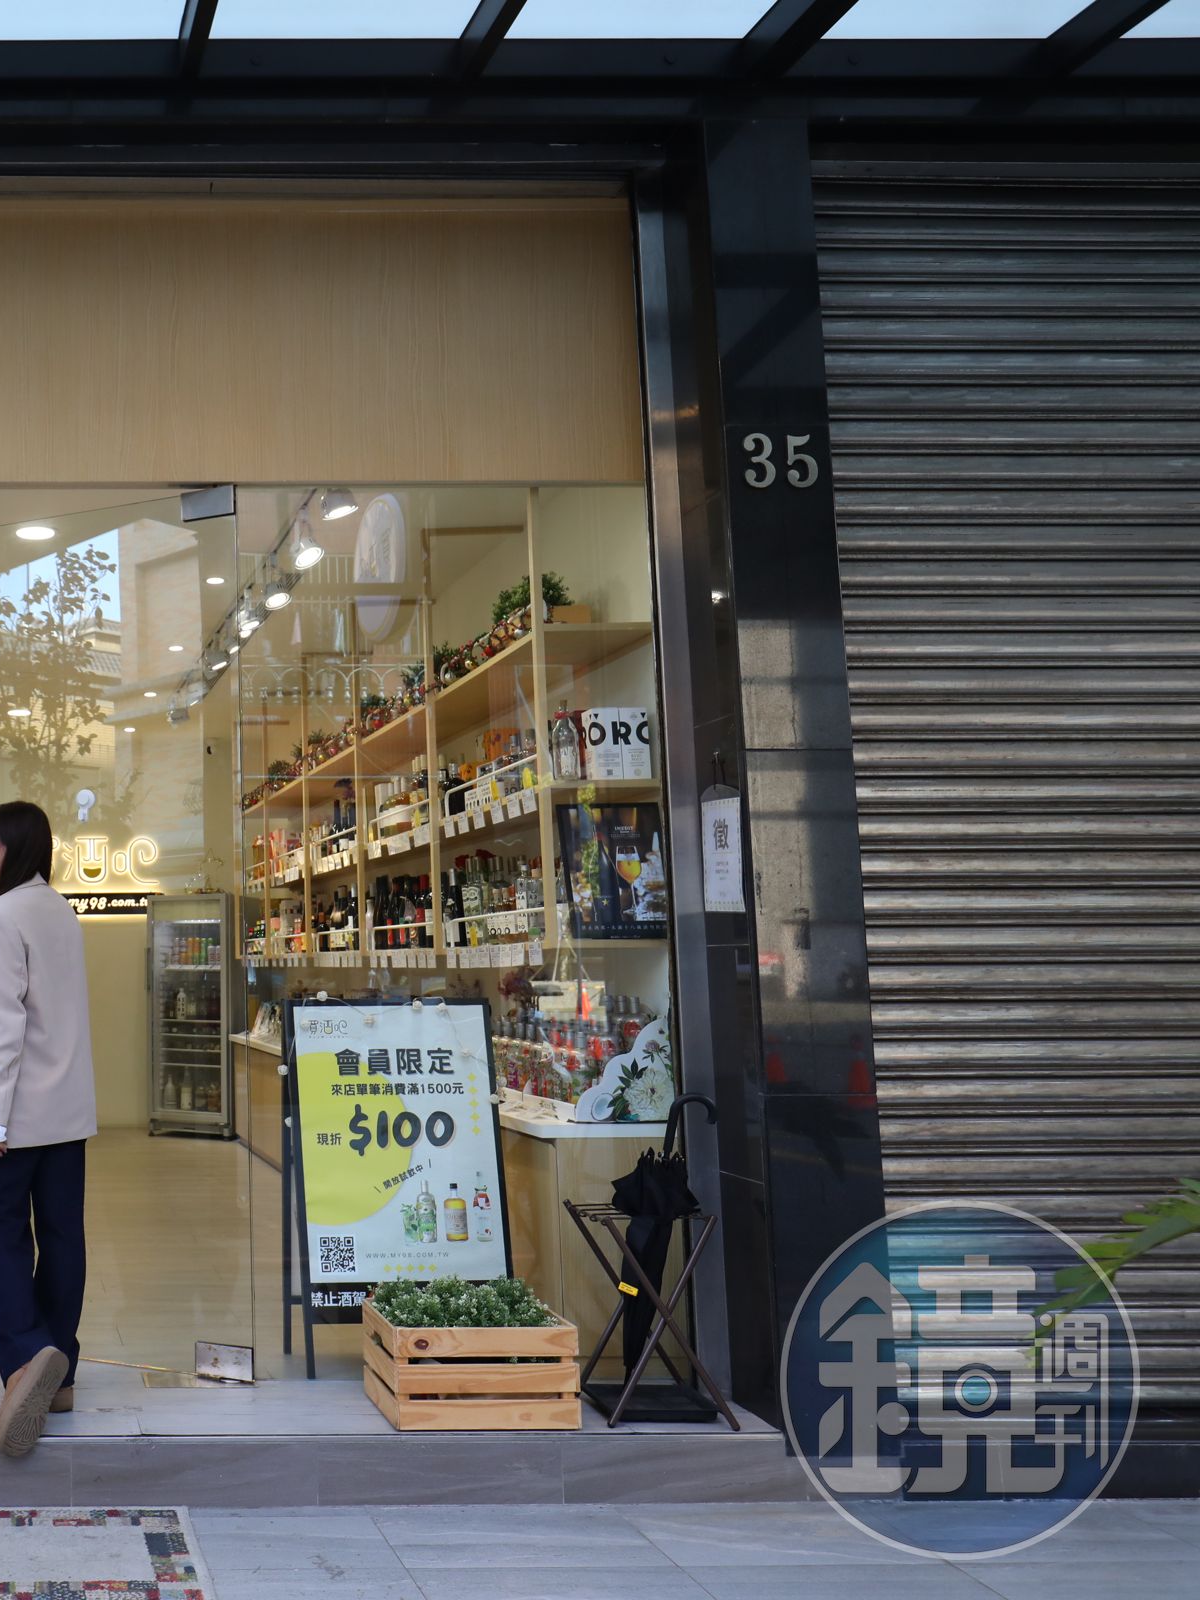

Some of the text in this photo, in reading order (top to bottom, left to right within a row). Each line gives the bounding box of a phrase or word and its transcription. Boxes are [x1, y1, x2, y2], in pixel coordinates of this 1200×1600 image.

[743, 432, 819, 488] 35
[712, 818, 730, 850] 徵
[52, 836, 160, 884] 酒吧
[335, 1048, 455, 1076] 會員限定
[331, 1082, 464, 1096] 來店單筆消費滿1500元
[316, 1104, 455, 1157] 現折 $100
[310, 1291, 367, 1308] 禁止酒駕
